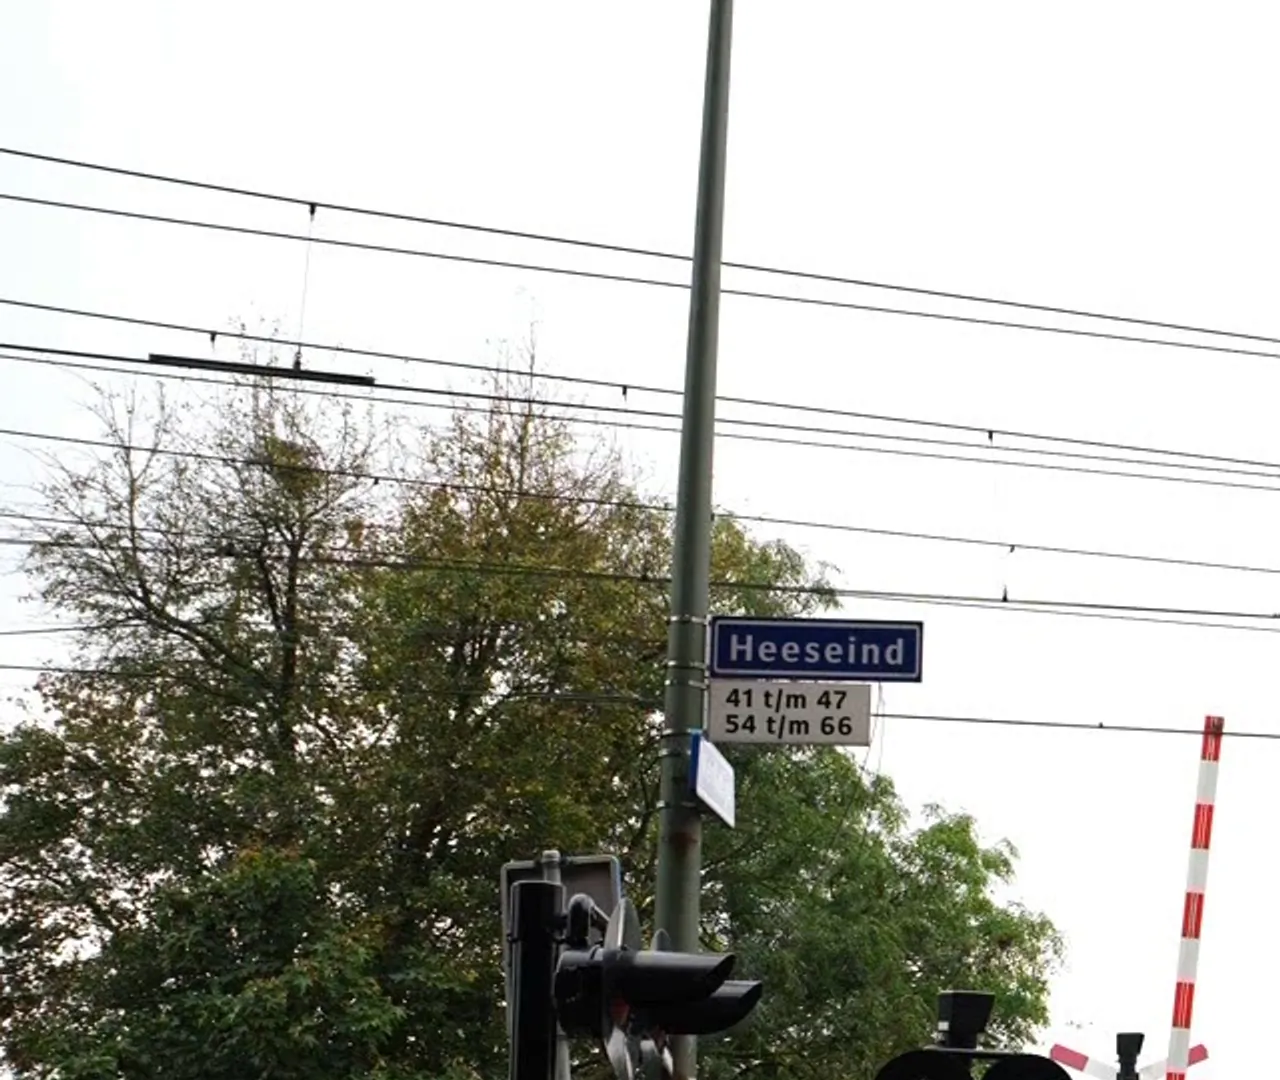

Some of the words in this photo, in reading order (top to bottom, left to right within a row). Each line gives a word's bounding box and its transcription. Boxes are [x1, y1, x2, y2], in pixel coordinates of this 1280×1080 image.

[729, 632, 904, 666] Heeseind
[725, 688, 753, 708] 41
[763, 688, 807, 713] t/m
[816, 690, 848, 710] 47
[724, 714, 756, 734] 54
[766, 715, 810, 739] t/m
[820, 716, 853, 736] 66
